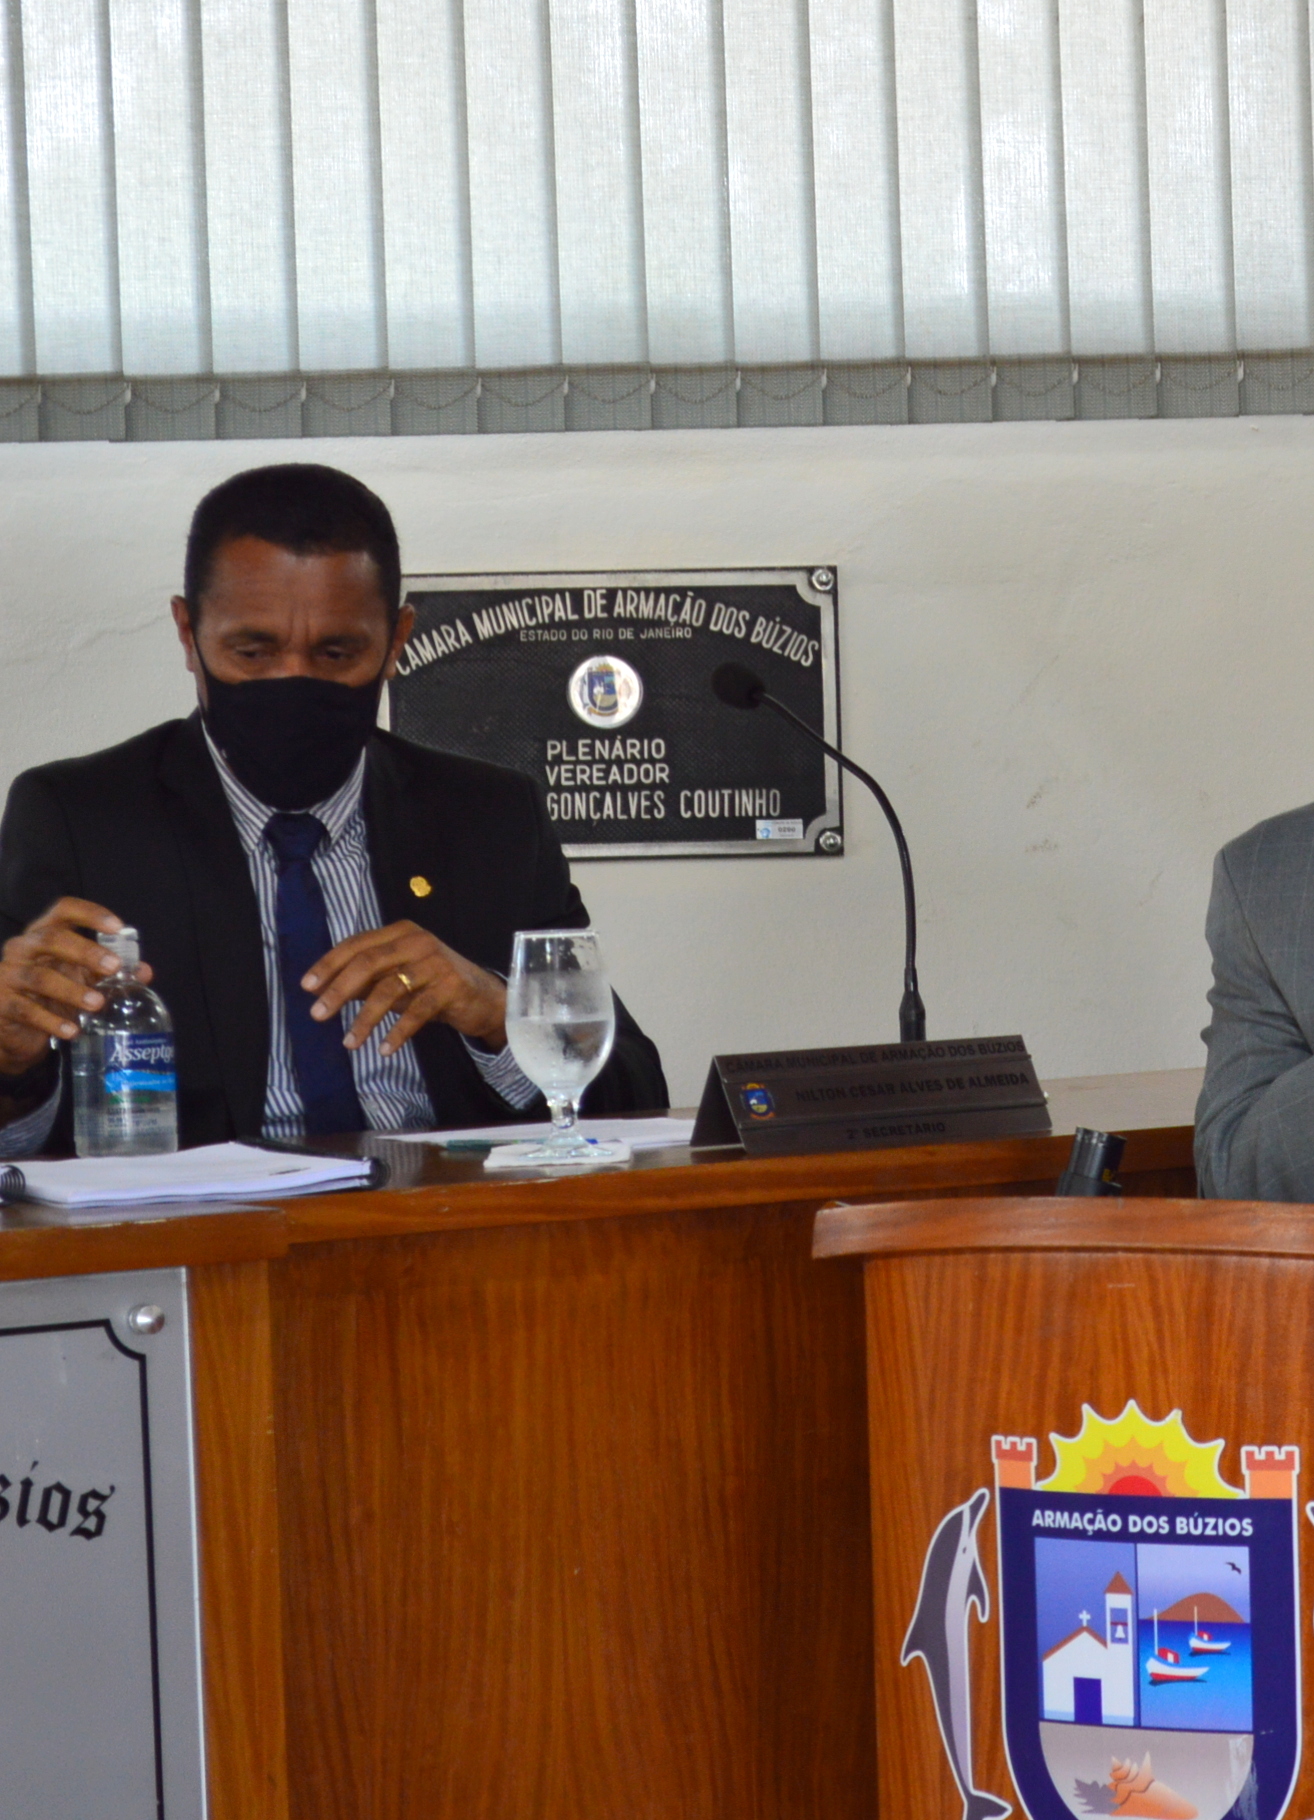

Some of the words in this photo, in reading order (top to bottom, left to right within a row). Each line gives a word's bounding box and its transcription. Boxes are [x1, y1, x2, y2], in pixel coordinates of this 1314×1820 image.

[472, 591, 579, 641] MUNICIPAL
[583, 589, 608, 619] DE
[613, 589, 706, 627] ARMAÇÃO
[709, 603, 750, 639] DOS
[751, 616, 820, 667] BÚZIOS
[519, 629, 567, 641] ESTADO
[571, 628, 588, 640] DO
[593, 628, 614, 640] RIO
[618, 628, 635, 640] DE
[640, 626, 692, 639] JANEIRO
[546, 735, 666, 761] PLENÁRIO
[545, 763, 669, 786] VEREADOR
[680, 788, 781, 818] COUTINHO
[785, 1053, 857, 1069] MUNICIPAL
[859, 1050, 877, 1064] DE
[881, 1044, 946, 1061] ARMAÇÃO
[948, 1044, 975, 1057] DOS
[795, 1087, 847, 1102] NILTON
[900, 1079, 944, 1094] ALVES
[946, 1077, 966, 1091] DE
[969, 1073, 1030, 1088] ALMEIDA
[1032, 1509, 1122, 1535] ARMAÇÃO
[1128, 1515, 1170, 1533] DOS
[1175, 1512, 1254, 1536] BÚZIOS
